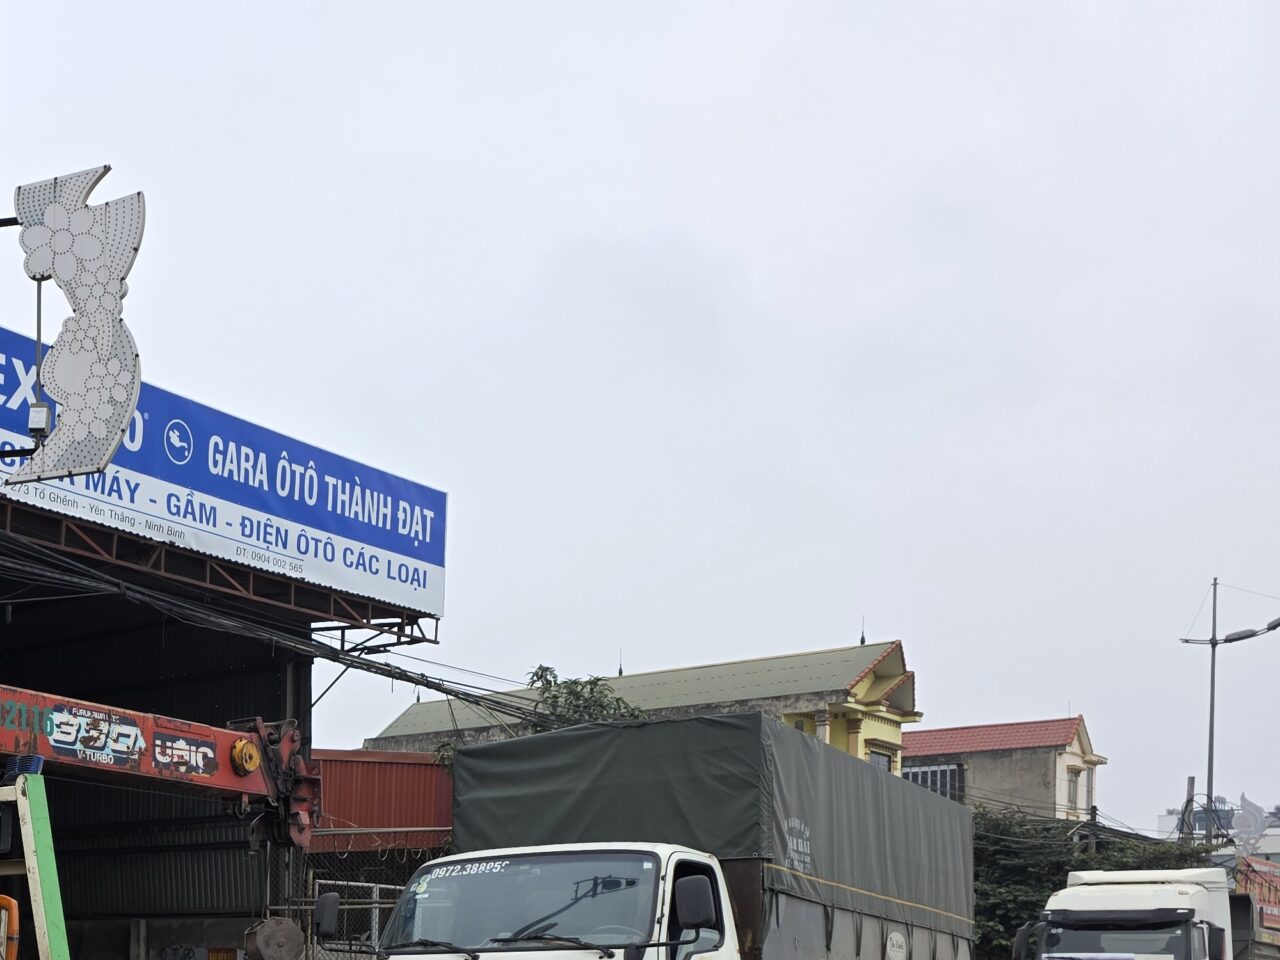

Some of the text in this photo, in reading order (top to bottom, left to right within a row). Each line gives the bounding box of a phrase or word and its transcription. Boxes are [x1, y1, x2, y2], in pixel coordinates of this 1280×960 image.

[208, 434, 435, 547] GARA ÔTÔ THÀNH ĐẠT
[145, 519, 164, 534] Ninh
[166, 489, 217, 528] GẦM
[240, 514, 289, 550] ĐIỆN
[296, 528, 336, 562] ÔTÔ
[343, 545, 380, 575] CÁC
[387, 559, 427, 591] LOẠI
[251, 551, 270, 566] 0904
[273, 555, 287, 569] 002
[289, 560, 304, 574] 565
[76, 750, 114, 765] V-TURBO
